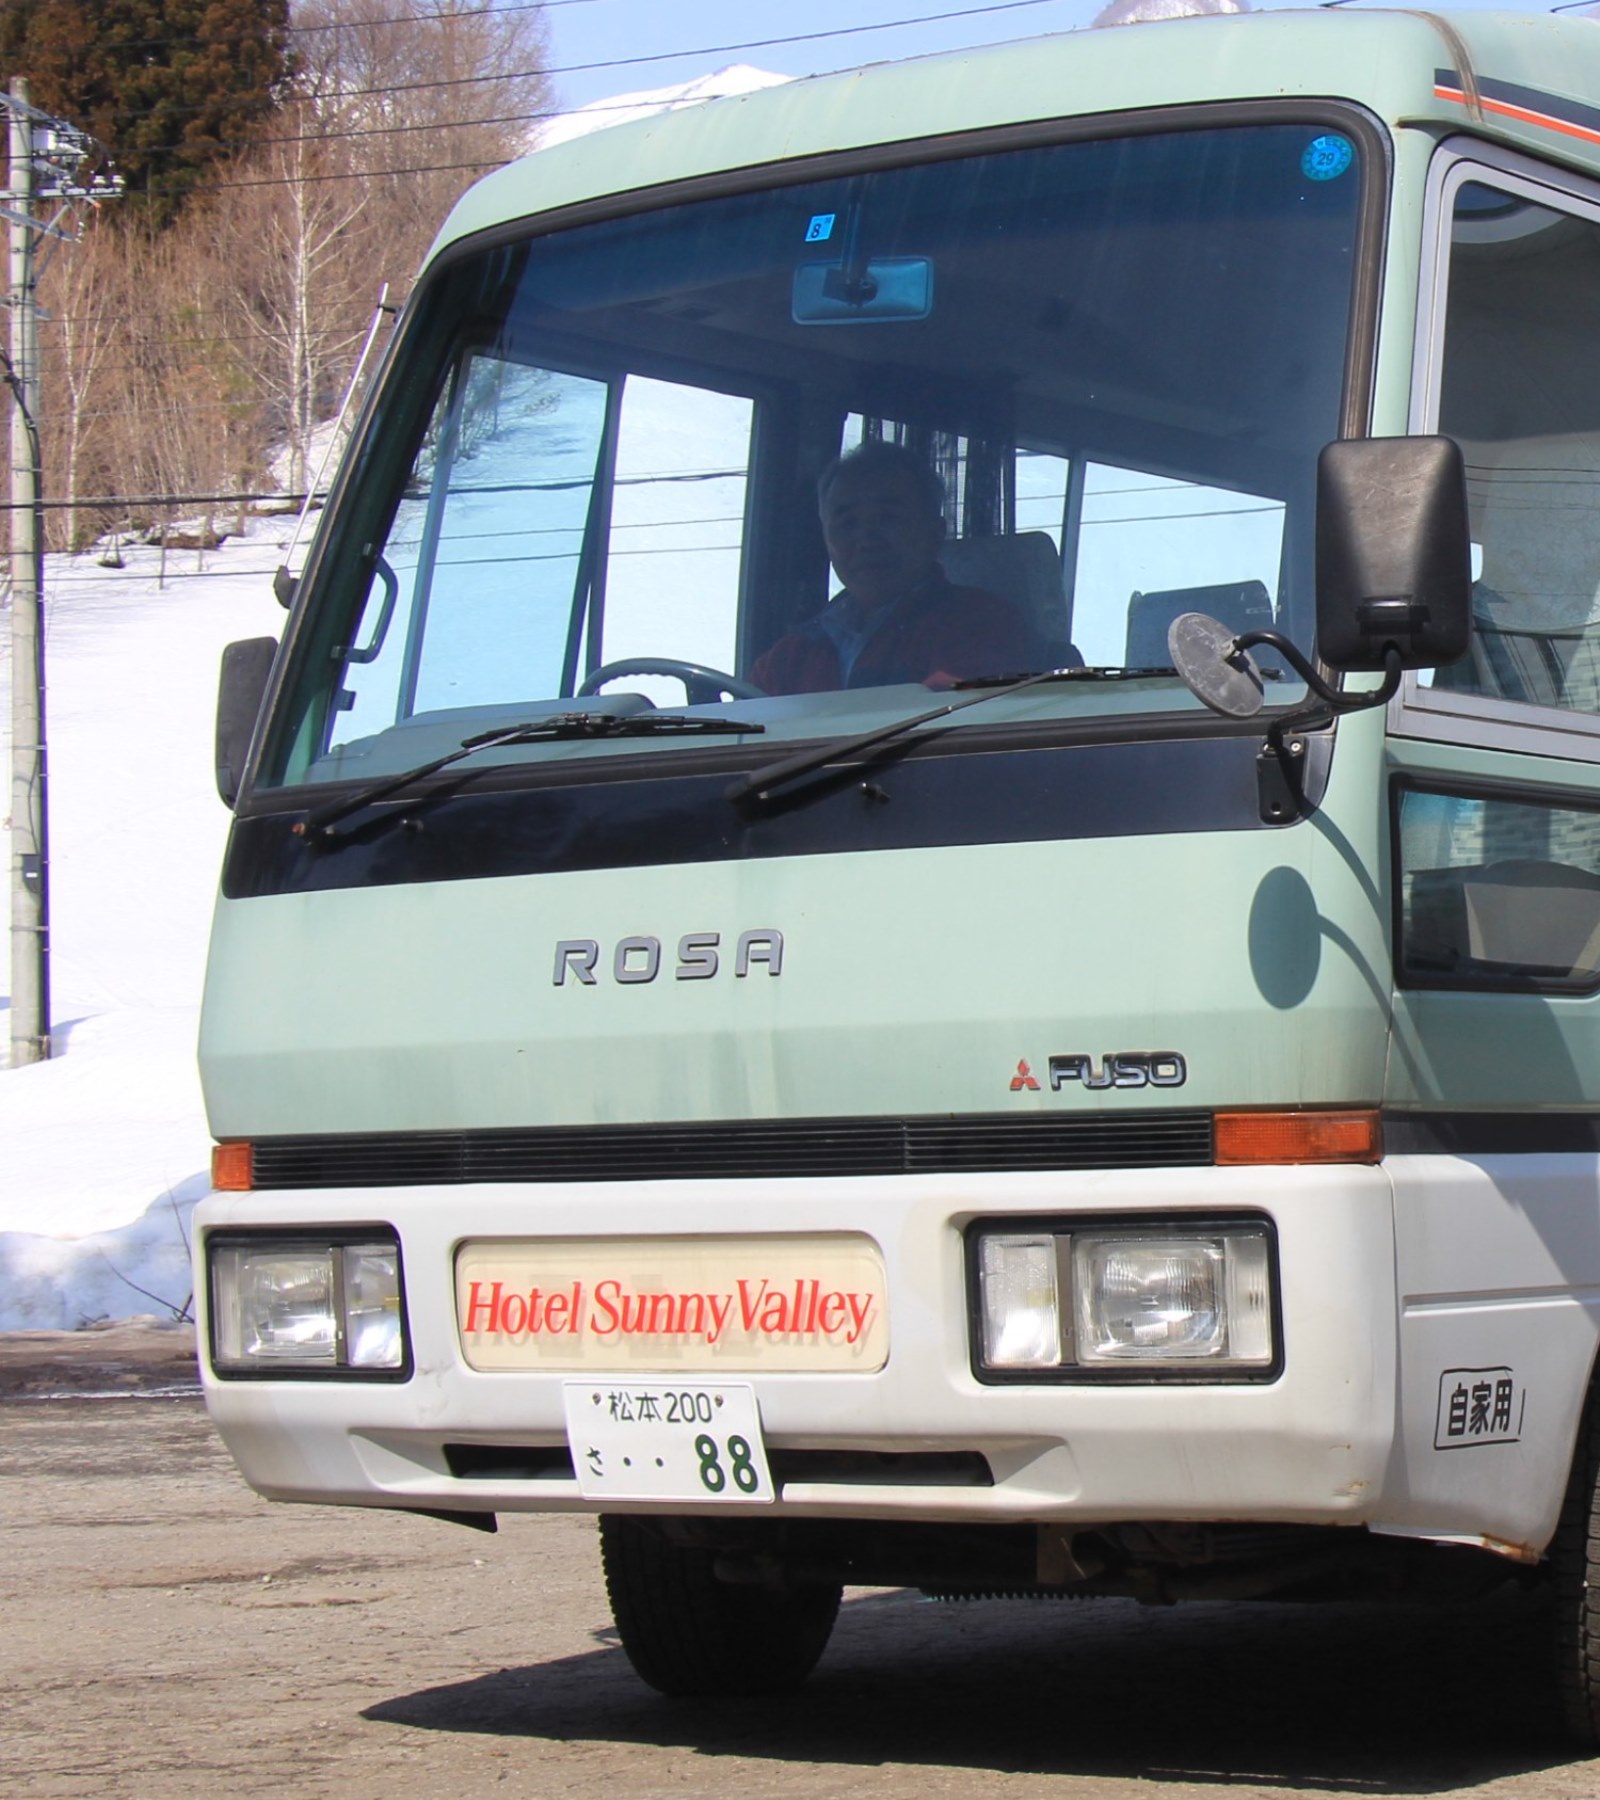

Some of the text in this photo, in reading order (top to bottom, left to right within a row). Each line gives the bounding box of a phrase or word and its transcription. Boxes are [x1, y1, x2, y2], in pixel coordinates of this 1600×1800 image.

[552, 928, 785, 986] ROSA
[1048, 1051, 1187, 1091] FUSO
[464, 1278, 875, 1345] Hotel Sunny Valley
[1448, 1379, 1513, 1436] 自家用
[695, 1433, 759, 1493] 88
